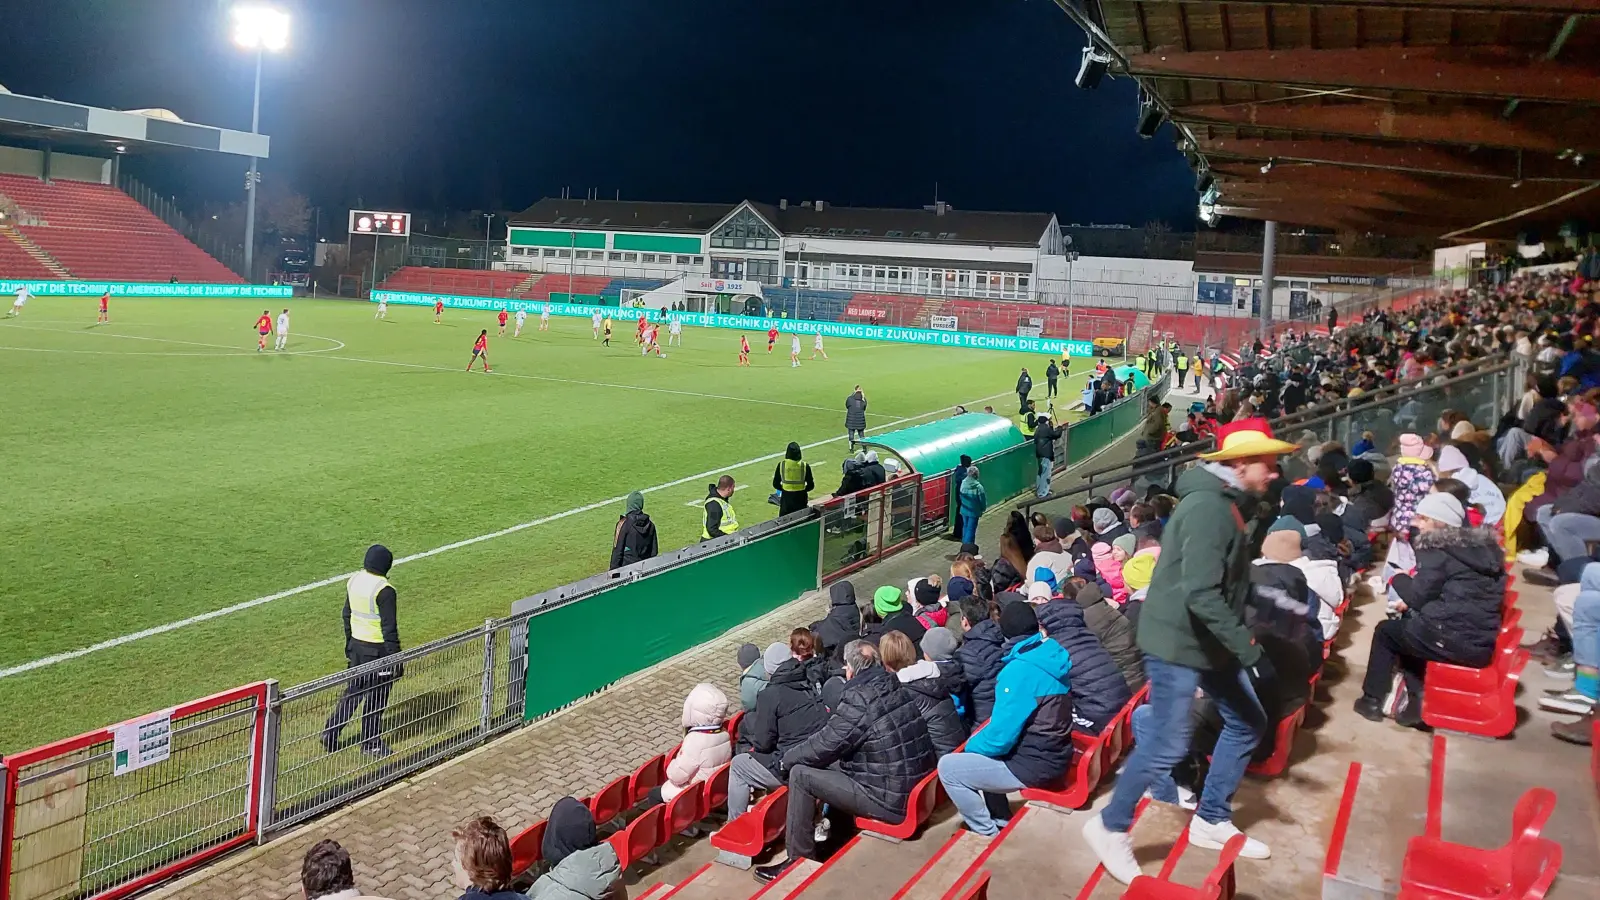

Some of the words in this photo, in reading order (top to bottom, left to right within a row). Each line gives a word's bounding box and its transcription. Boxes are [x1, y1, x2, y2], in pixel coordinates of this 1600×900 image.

[50, 283, 65, 294] DIE
[67, 283, 108, 294] TECHNIK
[110, 284, 125, 295] DIE
[126, 284, 189, 295] ANERKENNUNG
[191, 286, 203, 295] DIE
[205, 286, 239, 295] ZUKUNFT
[241, 287, 252, 296] DIE
[253, 287, 282, 296] TECHNIK
[858, 308, 876, 317] LADIES
[453, 297, 492, 308] ZUKUNFT
[494, 300, 507, 310] DIE
[549, 304, 562, 314] DIE
[636, 310, 652, 321] DE
[654, 312, 698, 325] ZKUNFT
[718, 316, 760, 328] TECHNIK
[763, 320, 780, 330] DIE
[782, 322, 864, 337] ANERKENNUNG
[866, 328, 884, 338] DIE
[886, 329, 940, 343] ZUKUNFT
[942, 333, 961, 345] DIE
[965, 334, 1017, 349] TECHNIK
[1019, 338, 1040, 350] DIE
[1042, 342, 1092, 354] ANERKE
